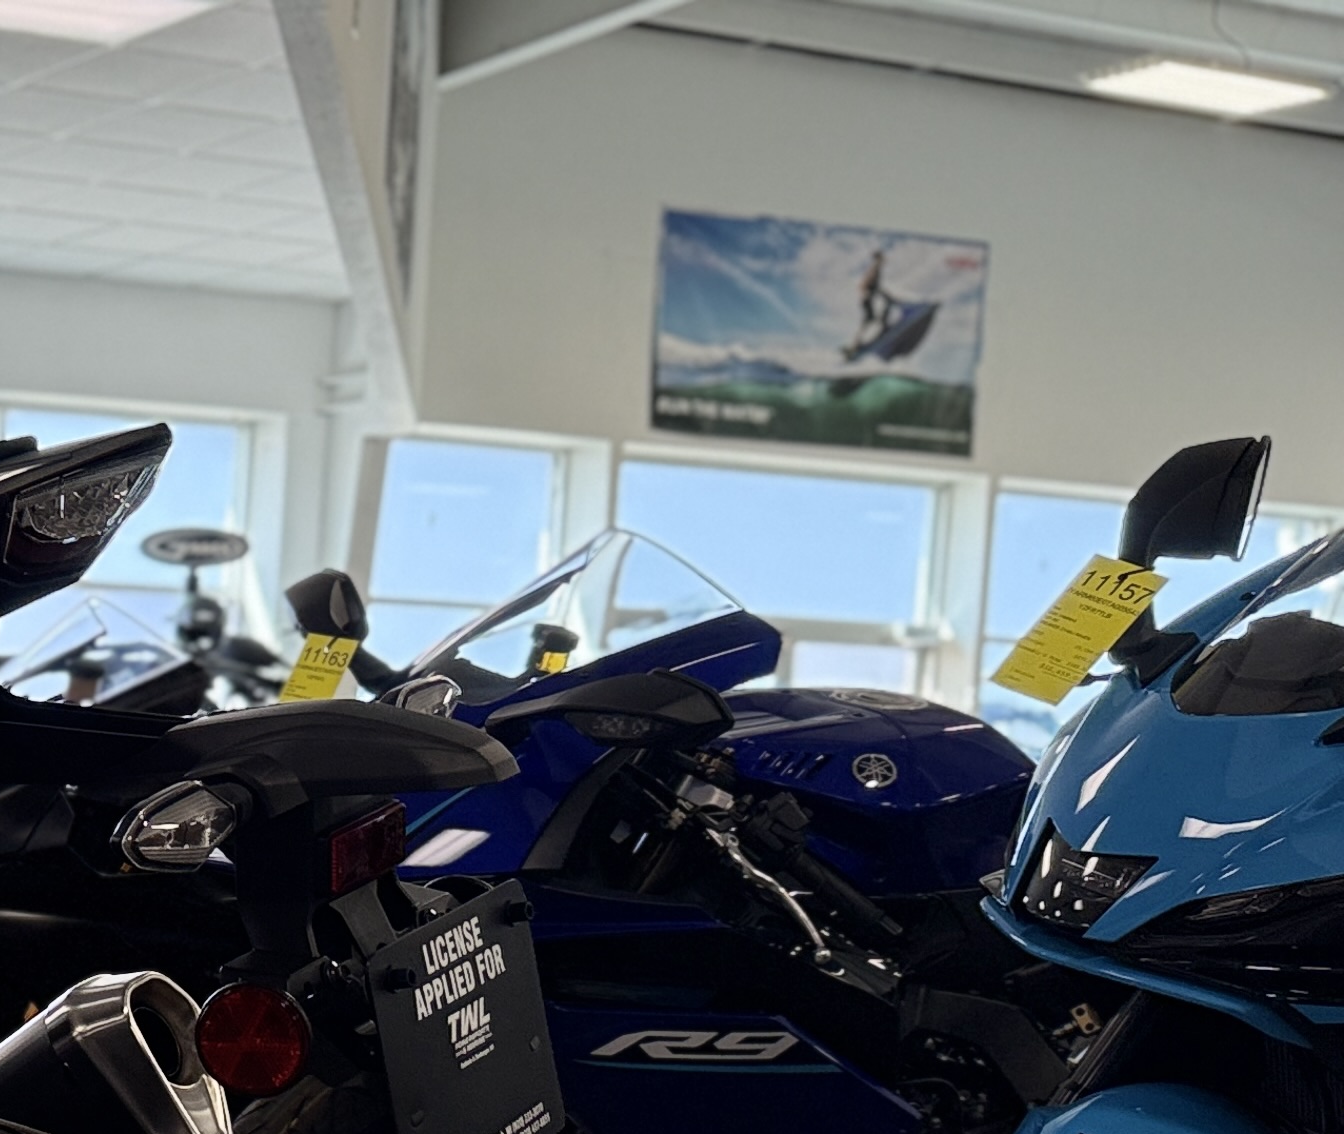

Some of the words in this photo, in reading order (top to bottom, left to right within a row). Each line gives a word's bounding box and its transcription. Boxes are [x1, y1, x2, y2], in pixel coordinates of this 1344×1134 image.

[1082, 569, 1156, 605] 11157
[304, 646, 350, 668] 11163
[421, 915, 484, 976] LICENSE
[413, 960, 477, 1021] APPLIED
[475, 943, 507, 986] FOR
[447, 996, 491, 1044] TWL
[589, 1029, 800, 1060] R9
